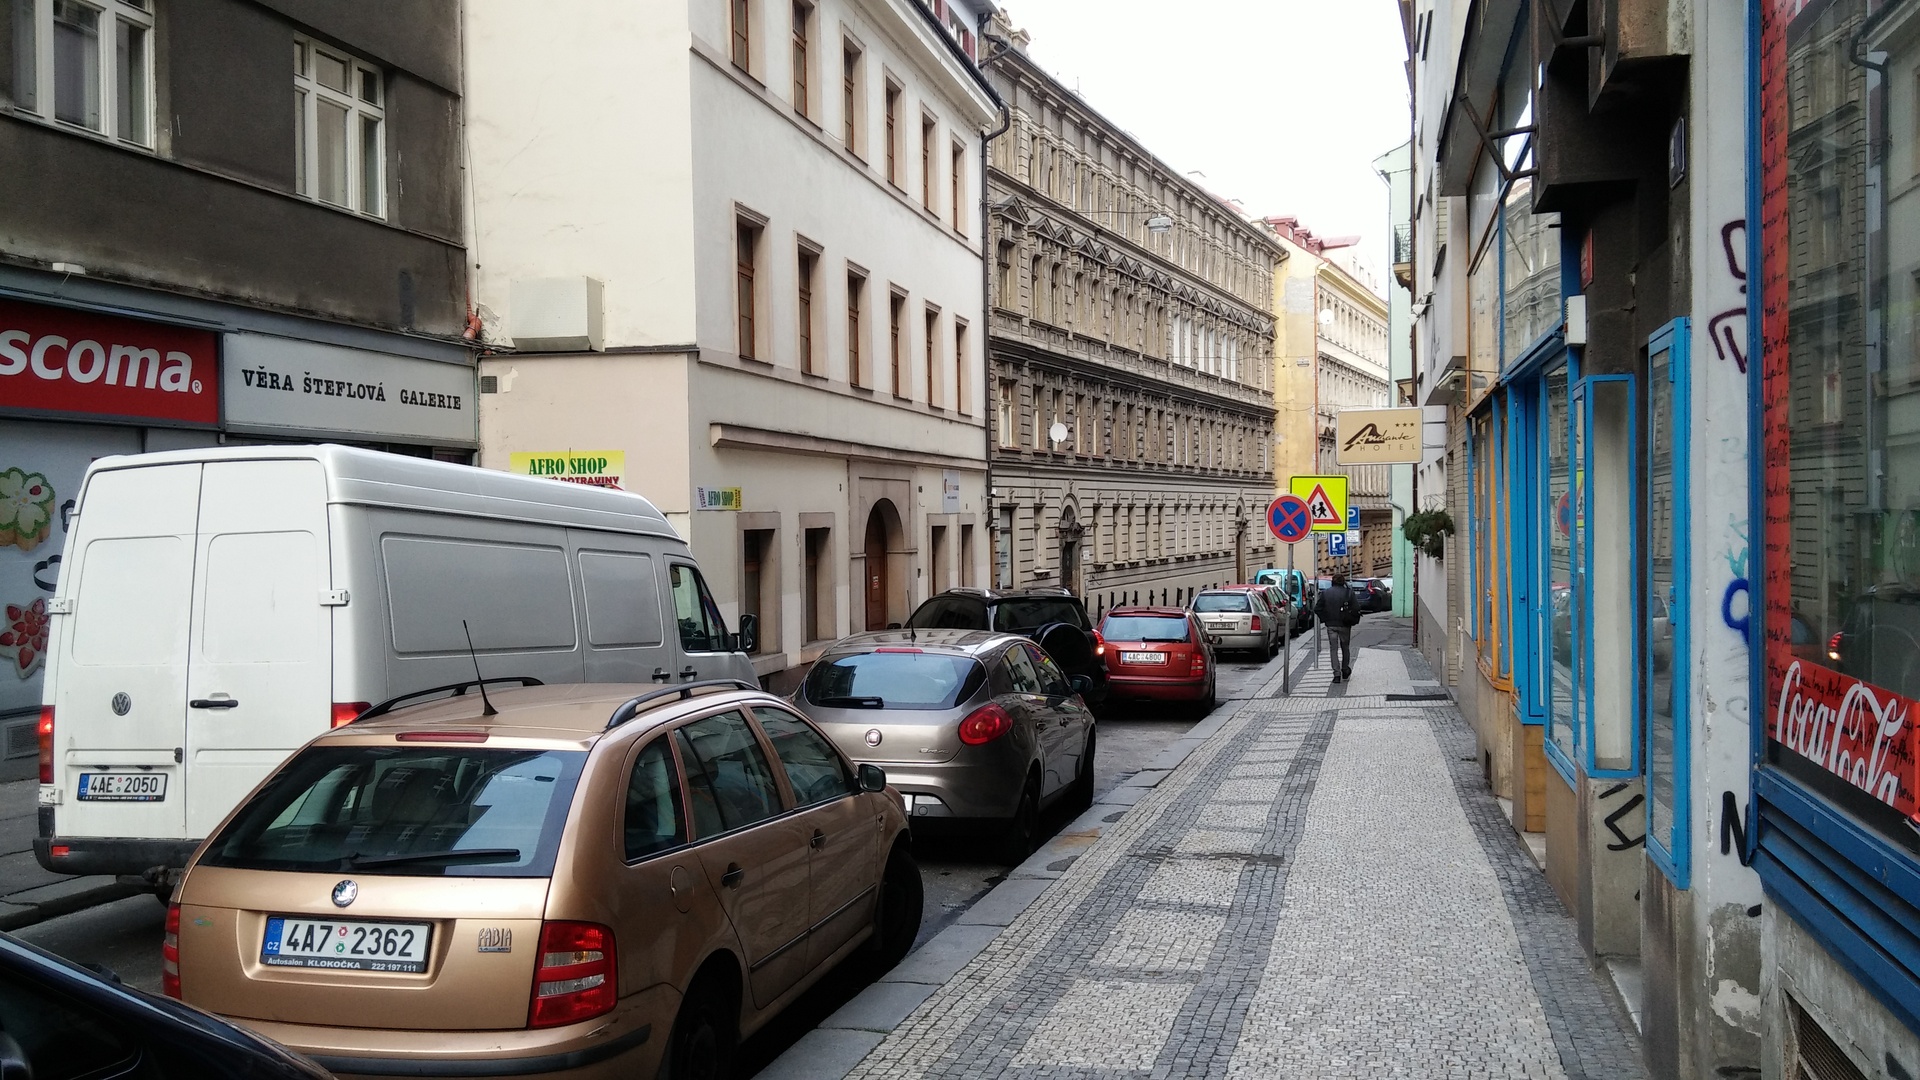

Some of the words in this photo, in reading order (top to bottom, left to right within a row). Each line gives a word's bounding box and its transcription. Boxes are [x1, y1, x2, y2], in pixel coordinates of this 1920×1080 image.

[242, 366, 294, 391] VĚRA
[303, 372, 386, 402] ŠTEFLOVÁ
[400, 388, 462, 410] GALERIE
[1343, 423, 1416, 452] Andante
[1360, 444, 1416, 452] HOTEL
[529, 458, 565, 475] AFRO
[569, 457, 608, 474] SHOP
[1331, 533, 1343, 549] P
[90, 777, 114, 793] 4AE
[124, 777, 158, 793] 2050
[286, 924, 333, 953] 4A7
[350, 927, 415, 957] 2362
[478, 927, 512, 947] FABIA
[267, 941, 279, 951] CZ
[267, 957, 304, 967] Autosalon
[307, 959, 361, 970] KLOKOČKA
[371, 962, 386, 971] 222
[387, 964, 401, 972] 197
